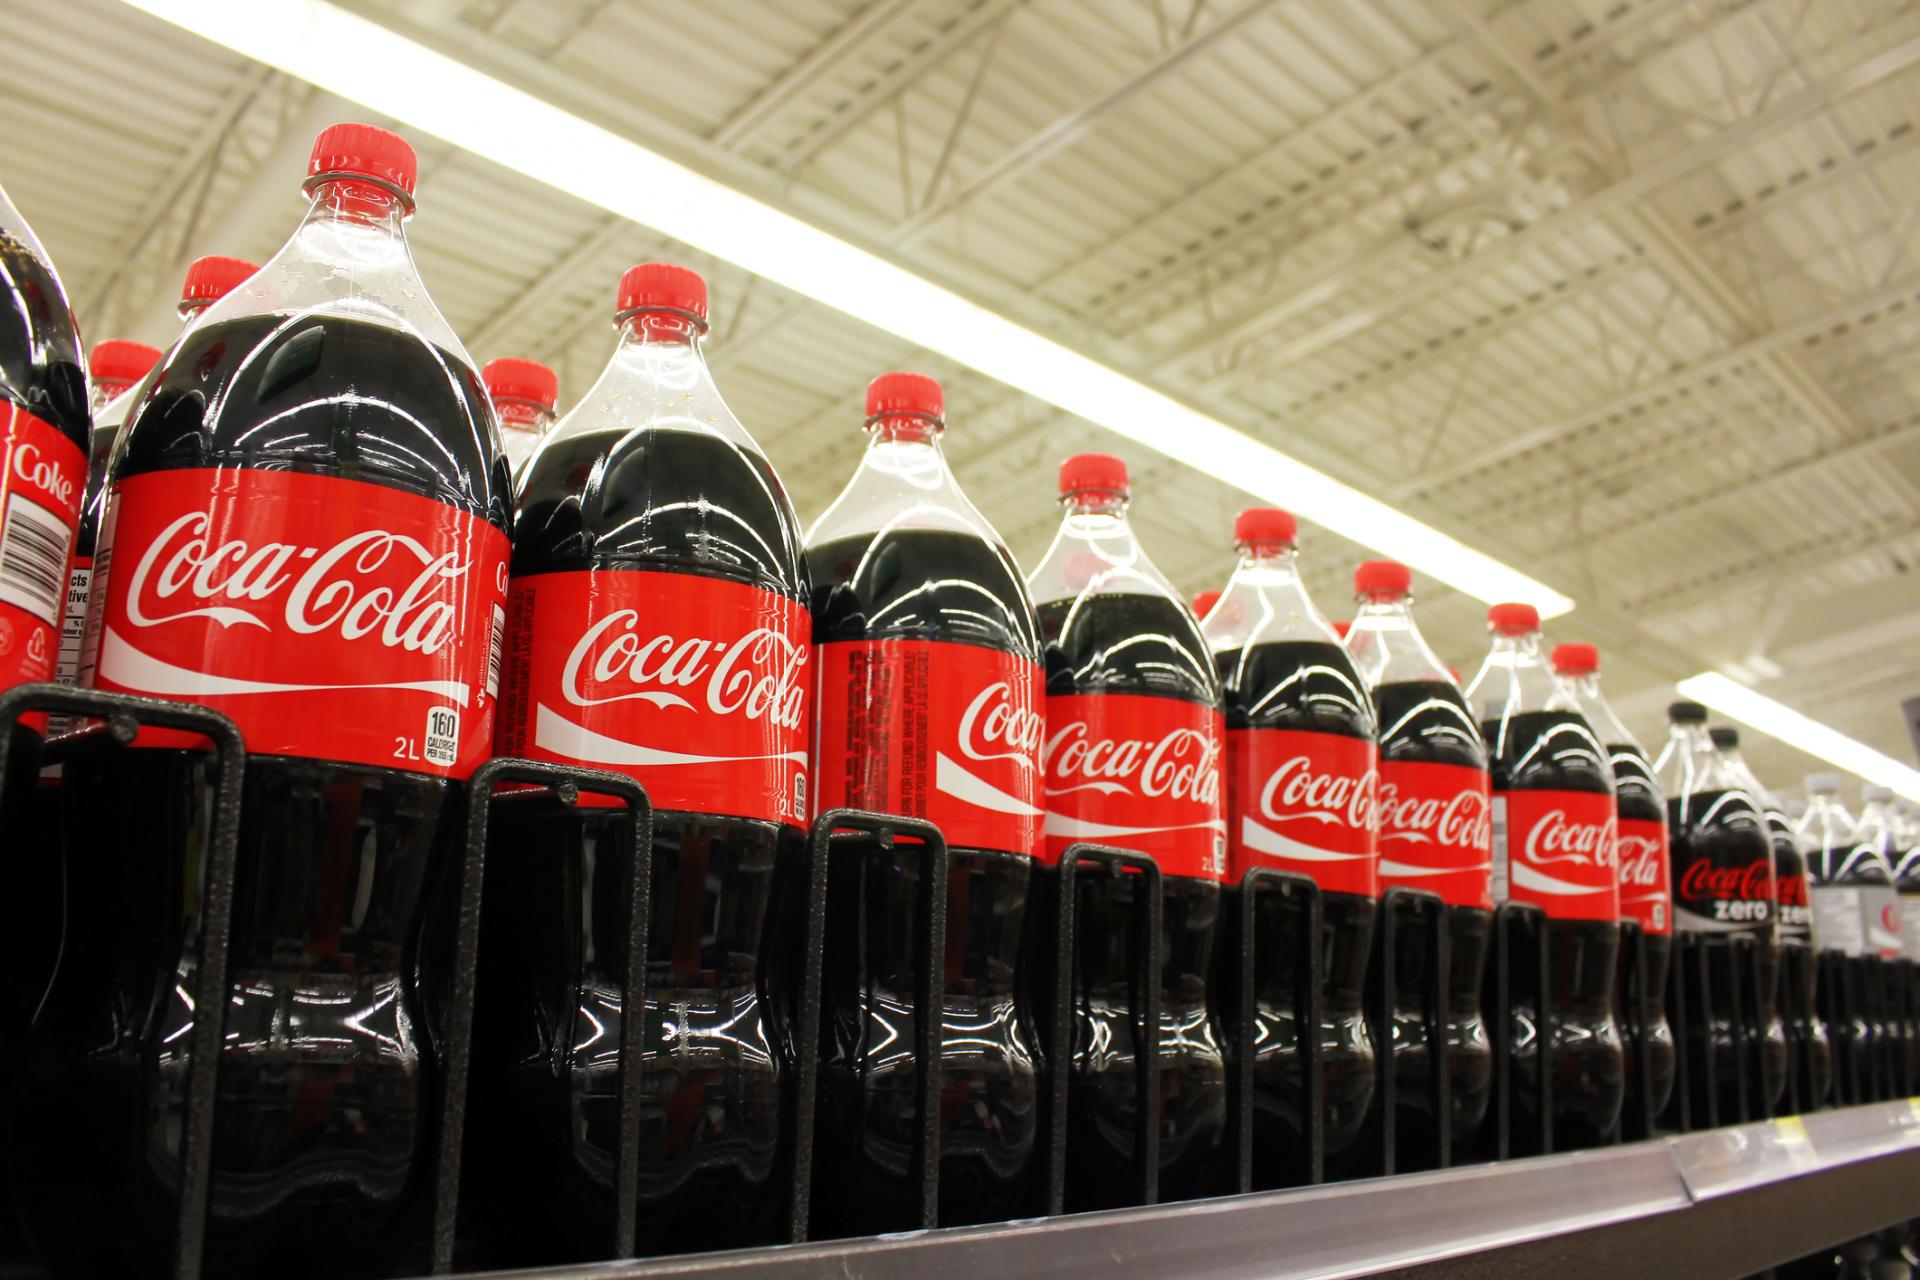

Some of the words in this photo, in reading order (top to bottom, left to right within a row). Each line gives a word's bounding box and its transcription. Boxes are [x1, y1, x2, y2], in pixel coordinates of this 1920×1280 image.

[14, 443, 70, 506] Coke
[70, 574, 88, 587] cts
[126, 511, 474, 655] Coca-Cola
[561, 609, 808, 731] Coca-Cola
[431, 711, 456, 738] 160
[393, 736, 420, 761] 2L
[1713, 901, 1768, 920] zero
